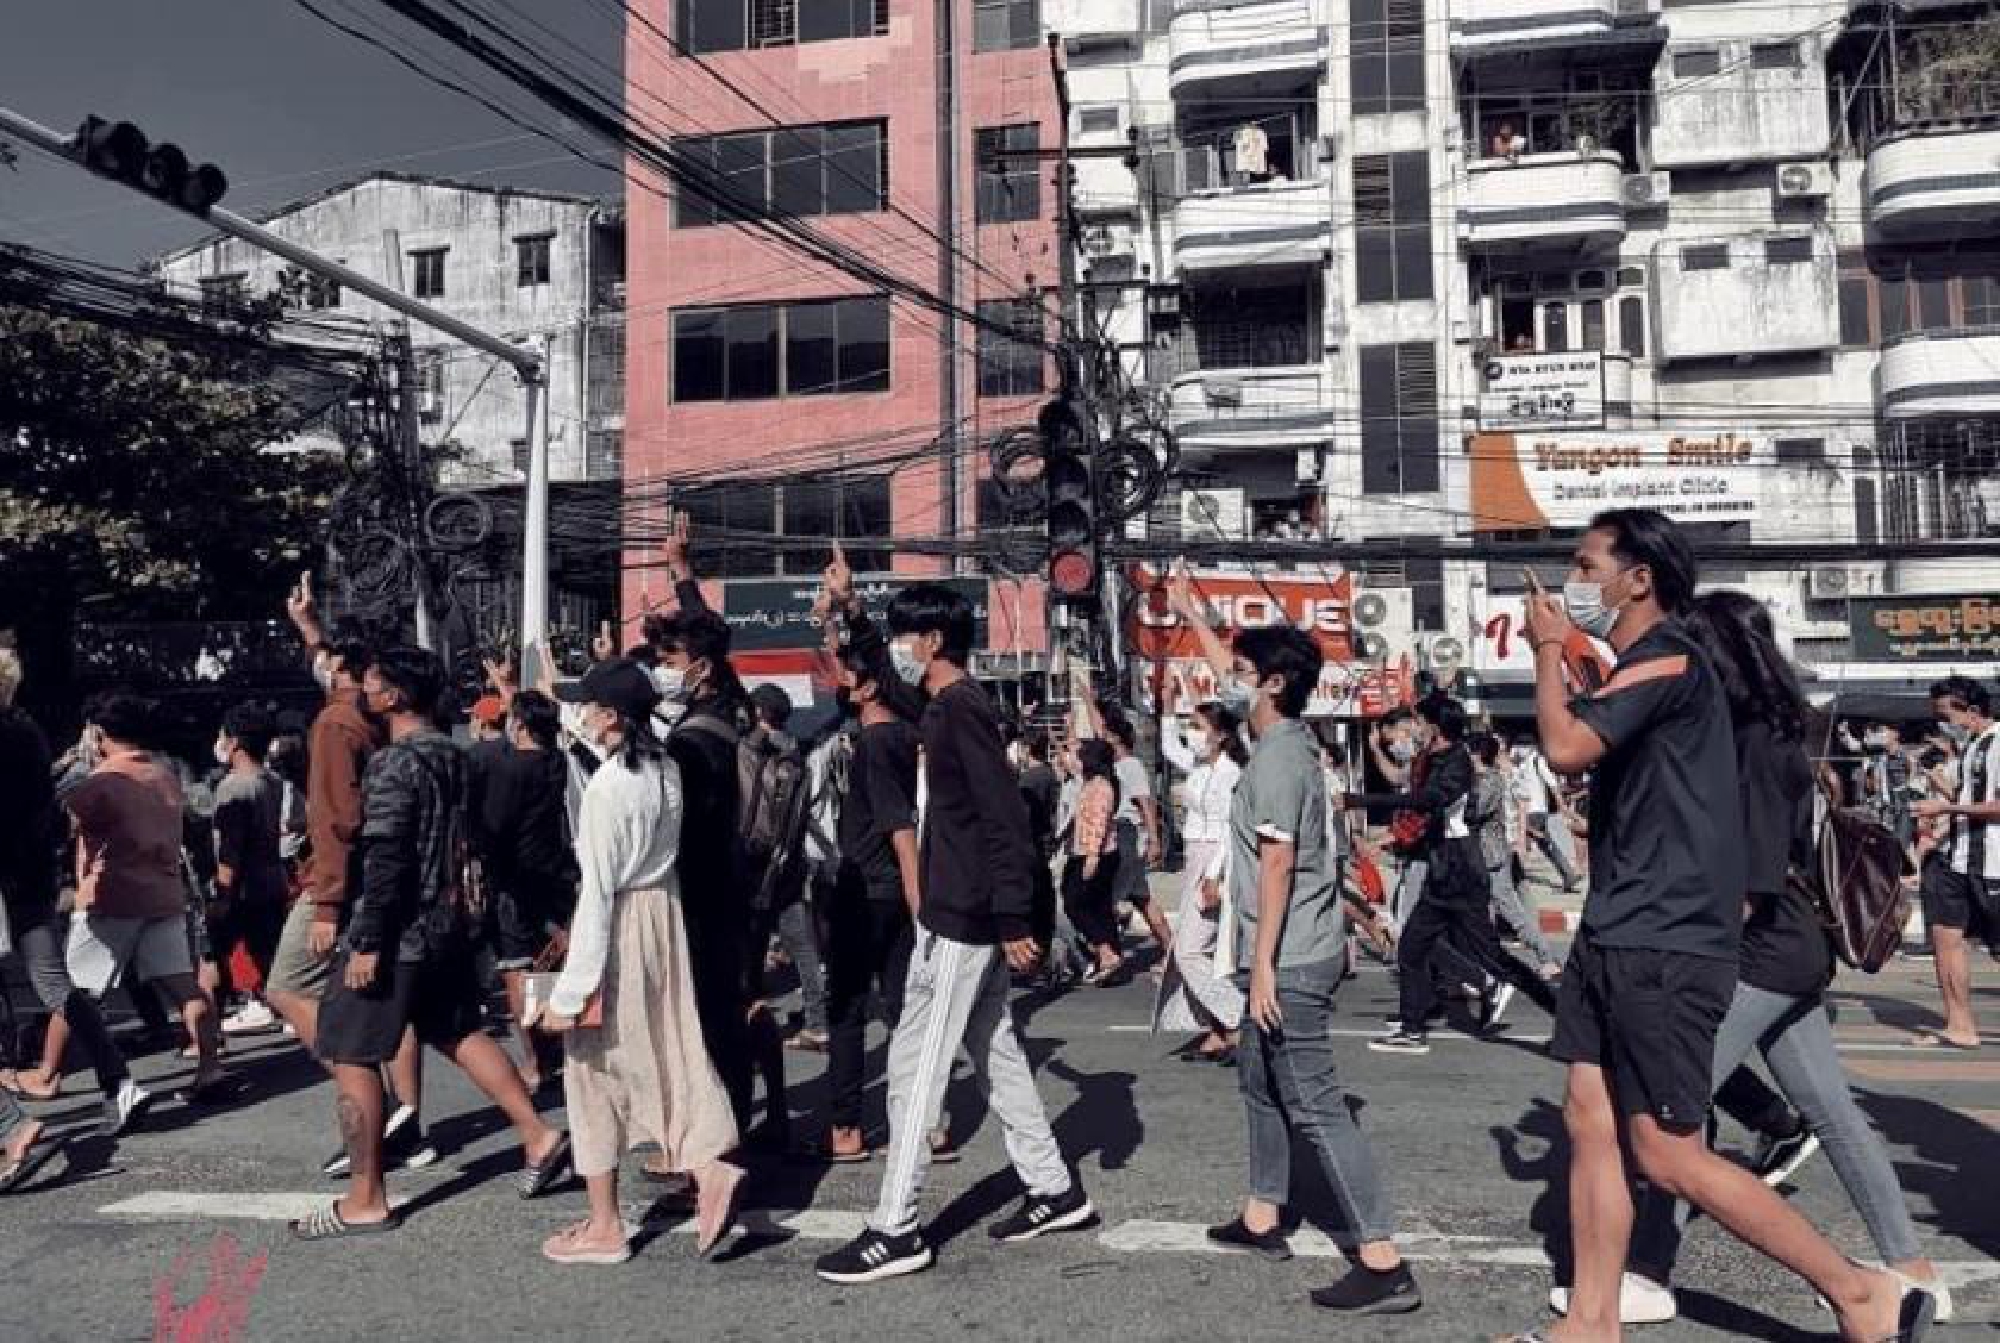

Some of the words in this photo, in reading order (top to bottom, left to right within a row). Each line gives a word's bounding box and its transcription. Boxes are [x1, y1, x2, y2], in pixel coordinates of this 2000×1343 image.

[1533, 442, 1641, 476] Yangon
[1667, 433, 1753, 467] Smile
[1554, 480, 1608, 501] Dental
[1679, 474, 1728, 496] Clinic
